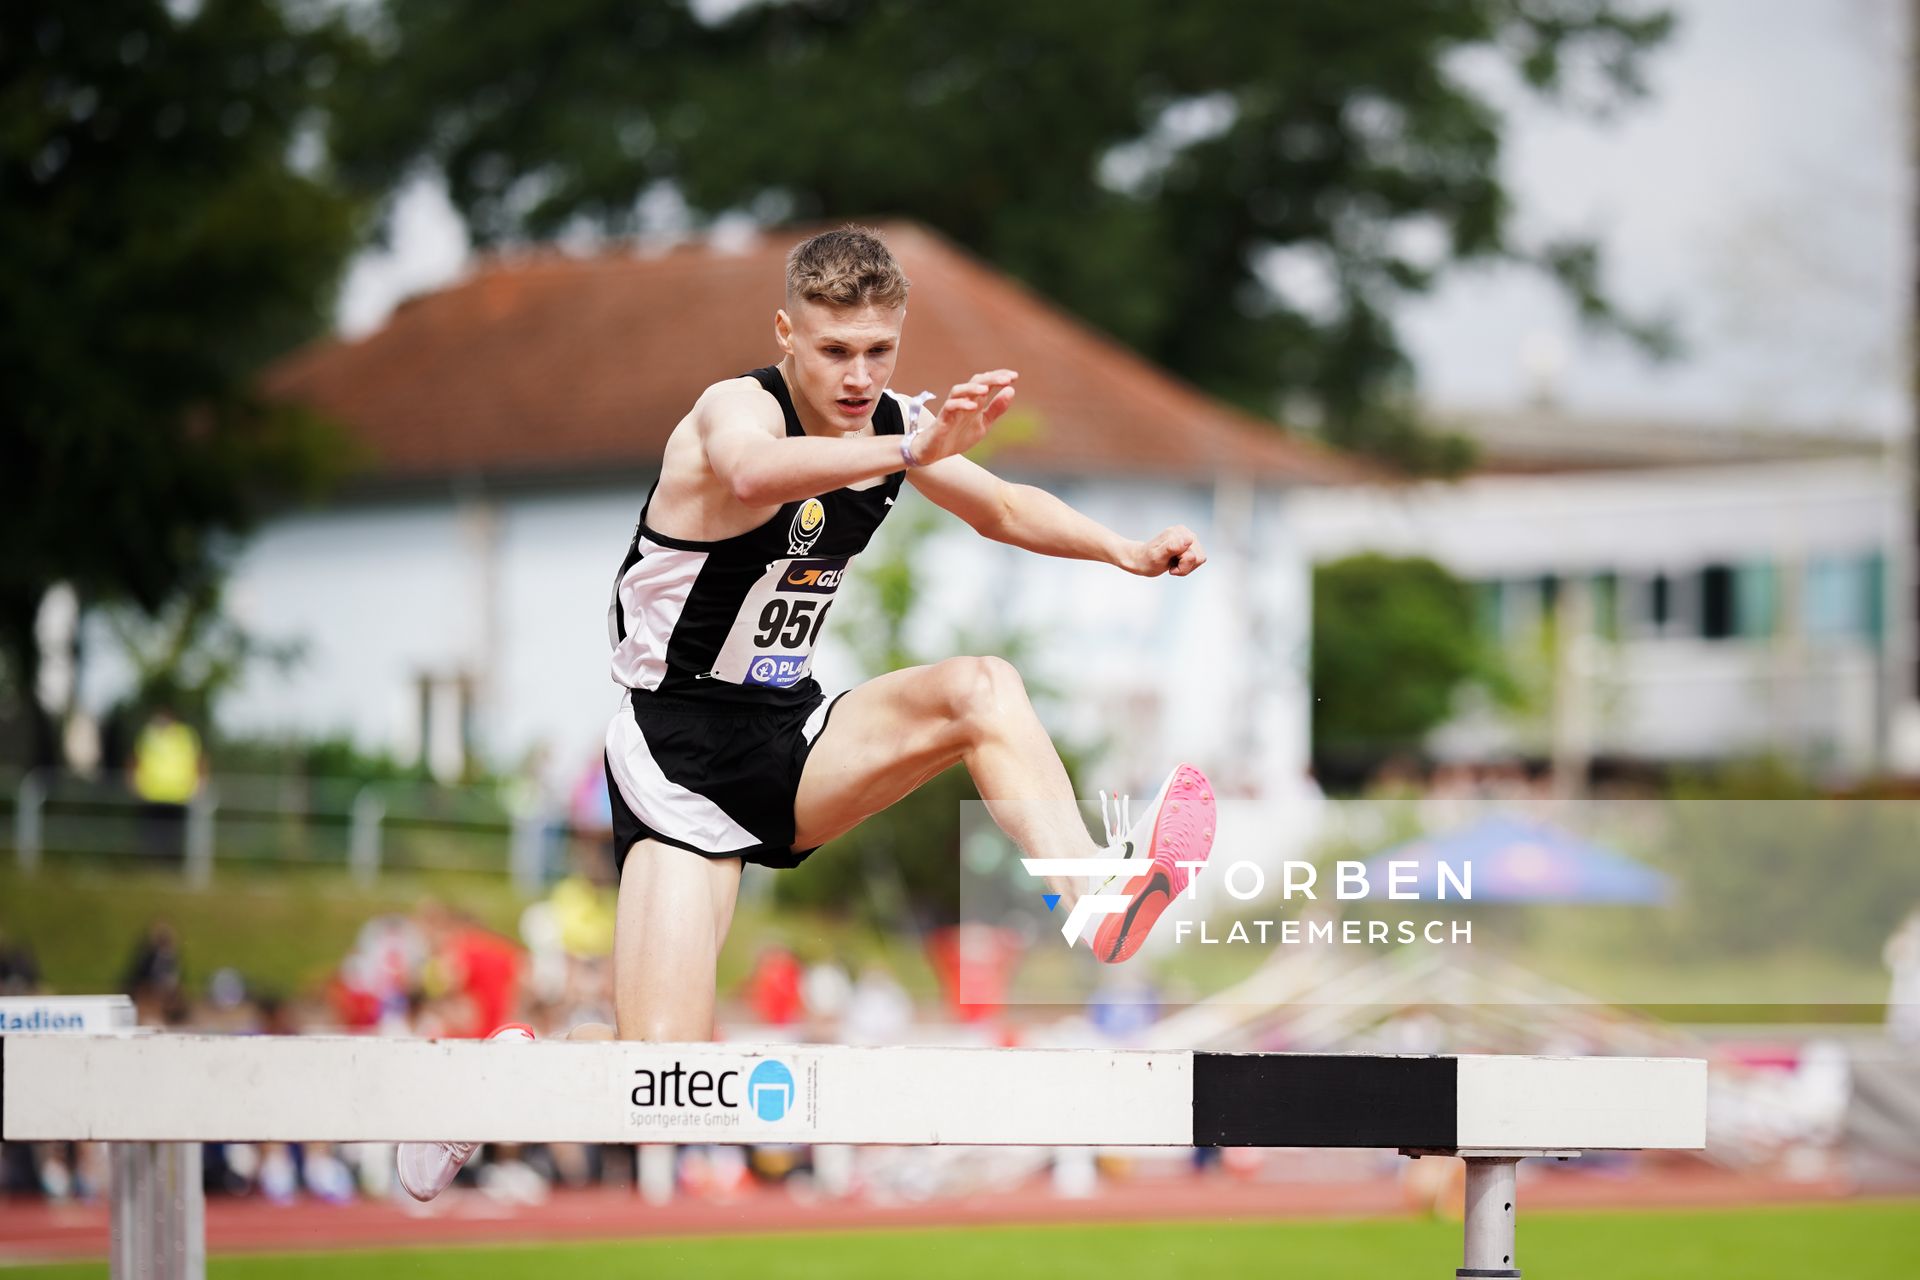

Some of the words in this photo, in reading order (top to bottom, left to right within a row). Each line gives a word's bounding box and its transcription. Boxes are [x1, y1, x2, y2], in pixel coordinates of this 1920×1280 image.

[631, 1061, 739, 1108] artec
[630, 1112, 702, 1128] Sportgeräte
[704, 1112, 739, 1126] GmbH
